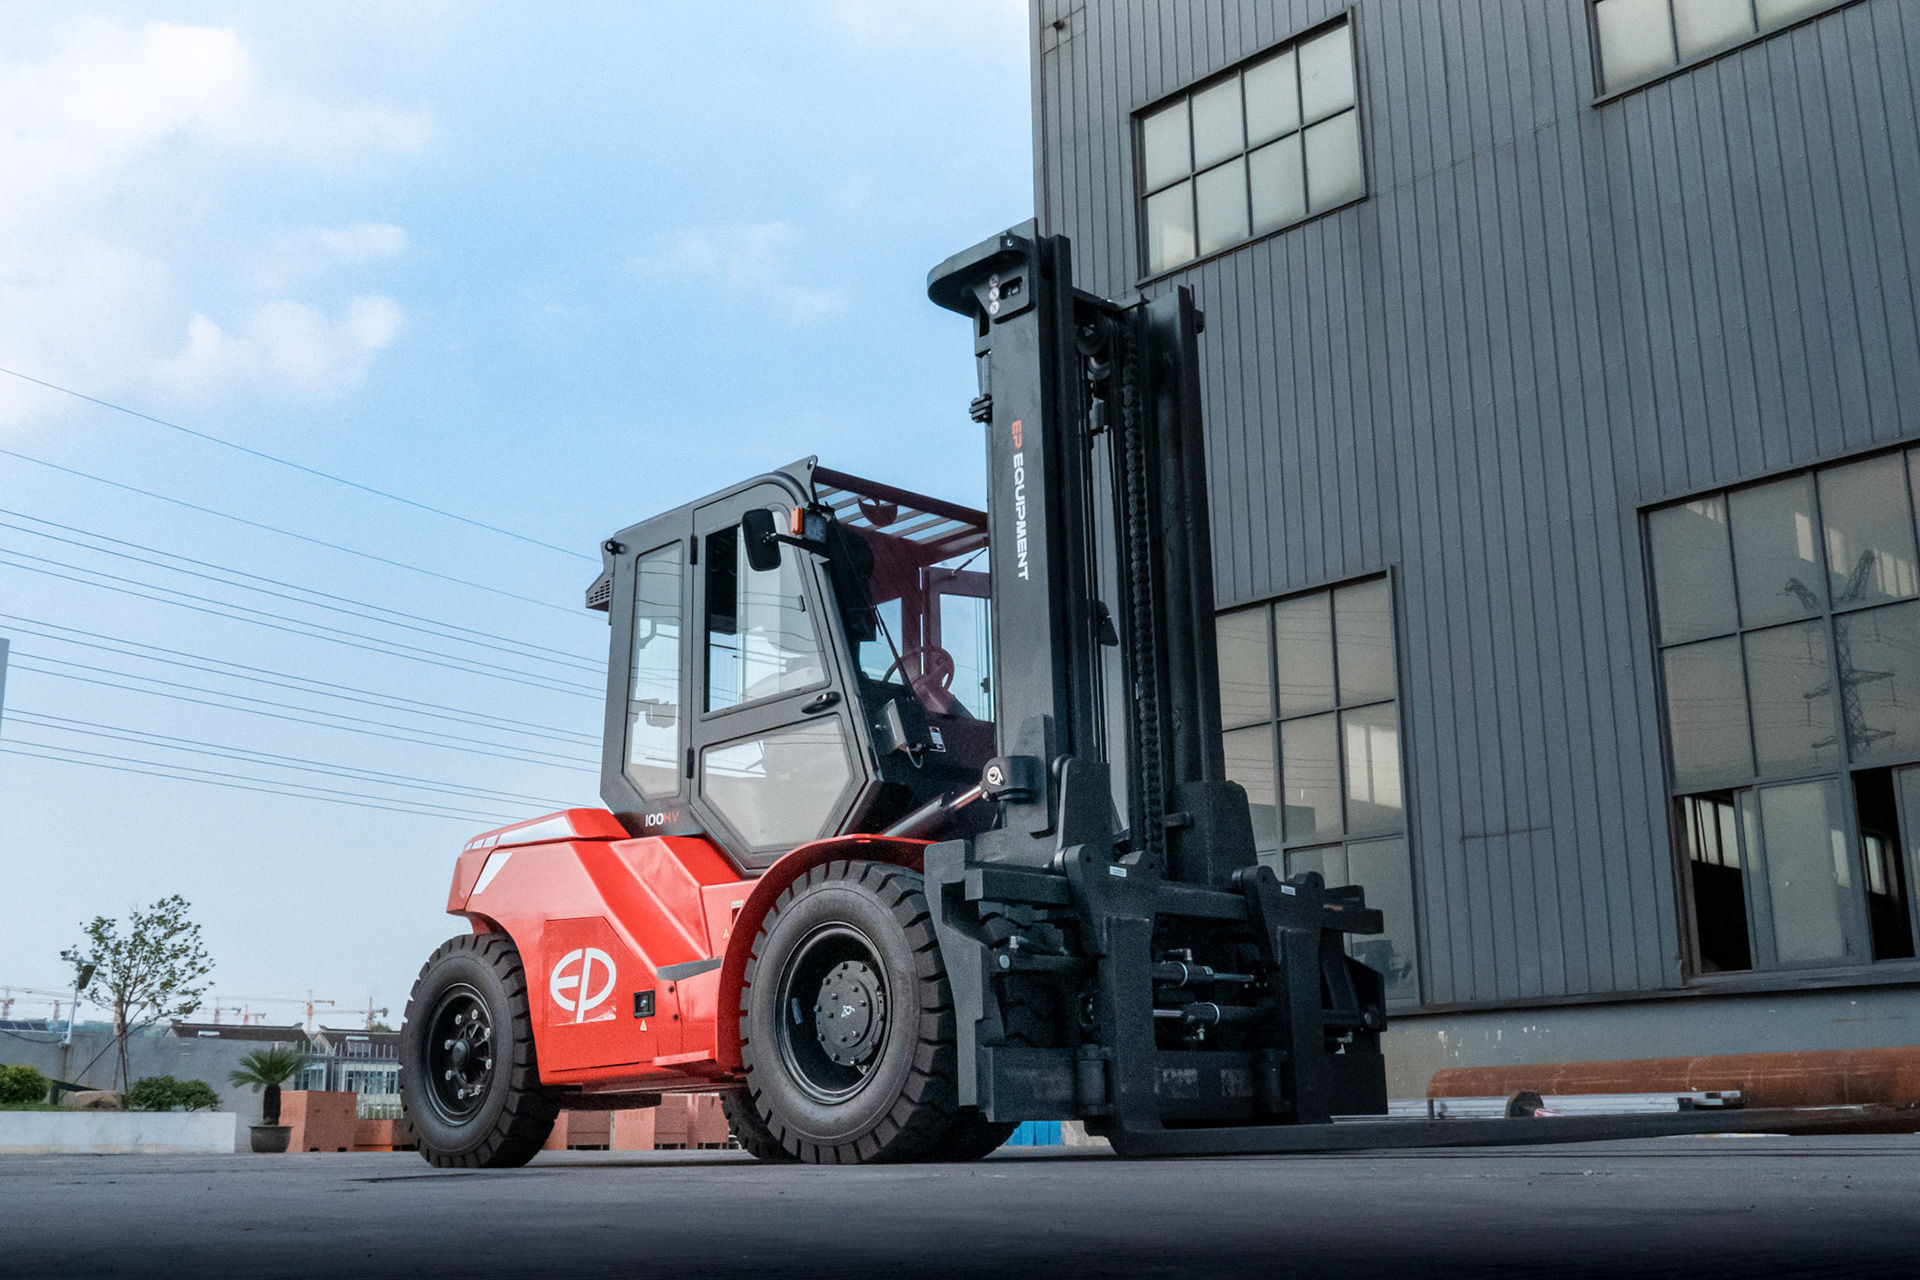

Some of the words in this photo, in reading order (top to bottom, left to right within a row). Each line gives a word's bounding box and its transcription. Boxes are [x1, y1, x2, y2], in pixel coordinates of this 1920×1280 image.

[1011, 419, 1023, 449] EP
[1013, 452, 1029, 580] EQUIPMENT
[549, 947, 617, 1024] EP
